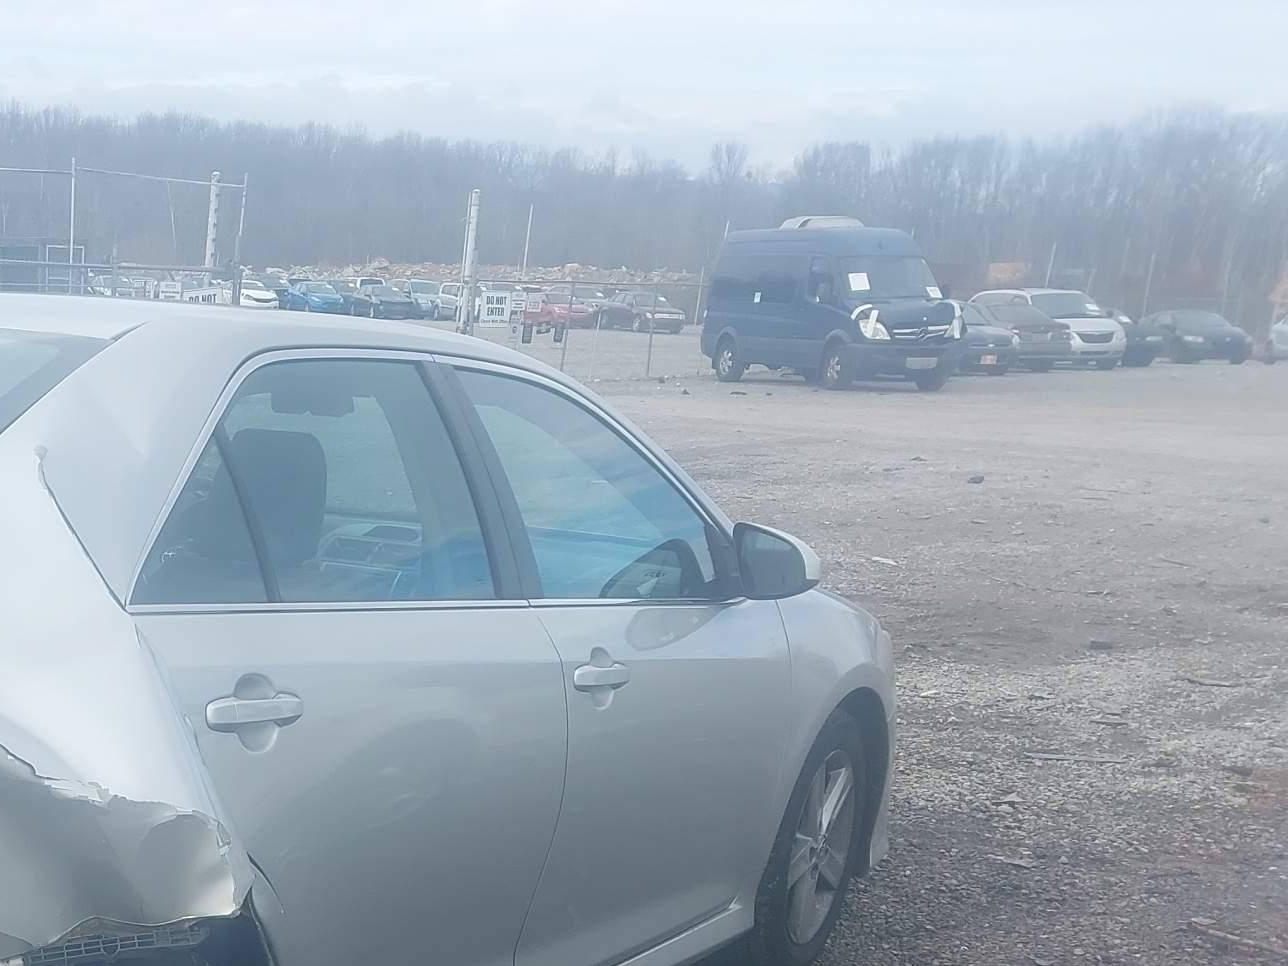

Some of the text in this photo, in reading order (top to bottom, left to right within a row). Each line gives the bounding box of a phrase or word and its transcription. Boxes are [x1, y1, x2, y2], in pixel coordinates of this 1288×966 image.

[486, 295, 495, 305] DO
[495, 296, 507, 306] NOT
[487, 306, 505, 317] ENTER
